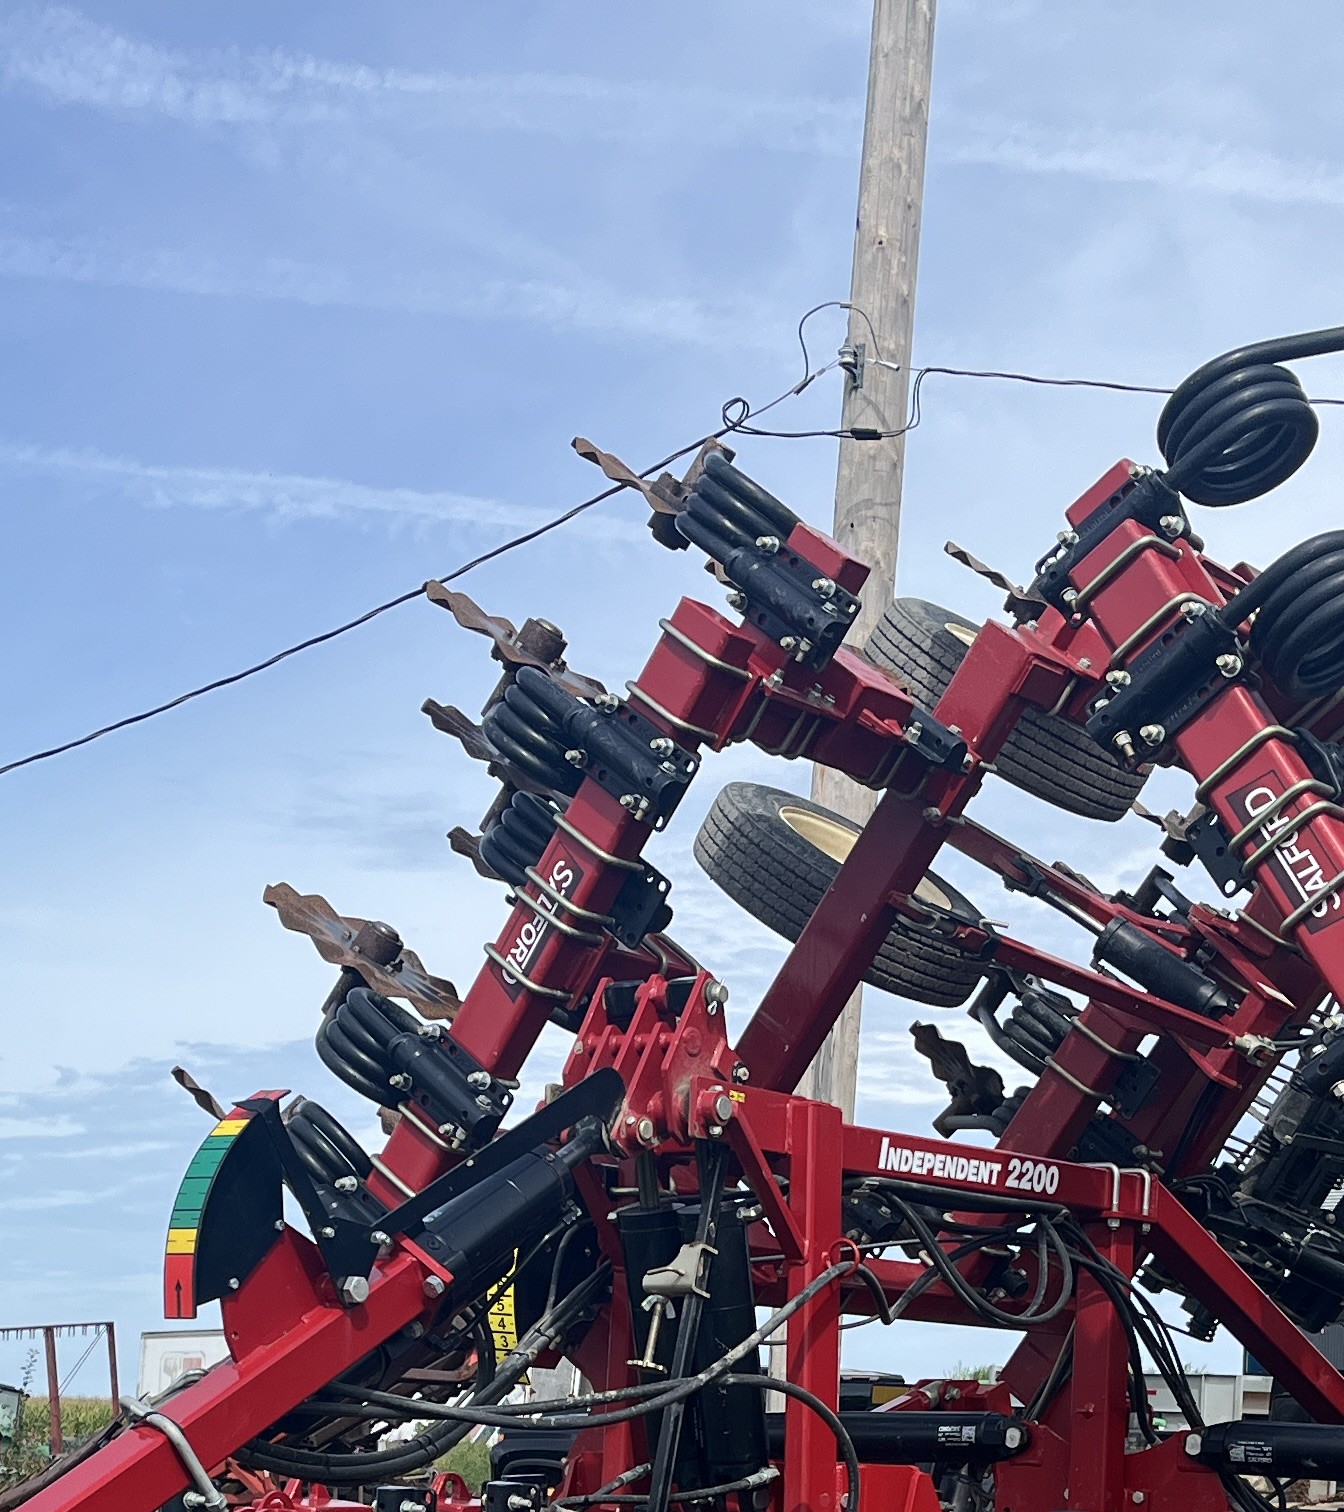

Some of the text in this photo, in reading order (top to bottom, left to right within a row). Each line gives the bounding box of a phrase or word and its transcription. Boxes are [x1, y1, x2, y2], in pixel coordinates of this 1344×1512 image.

[877, 1136, 1060, 1196] INDEPENDENT 2200
[497, 1298, 505, 1312] 5
[497, 1317, 507, 1331] 4
[500, 1335, 509, 1348] 3
